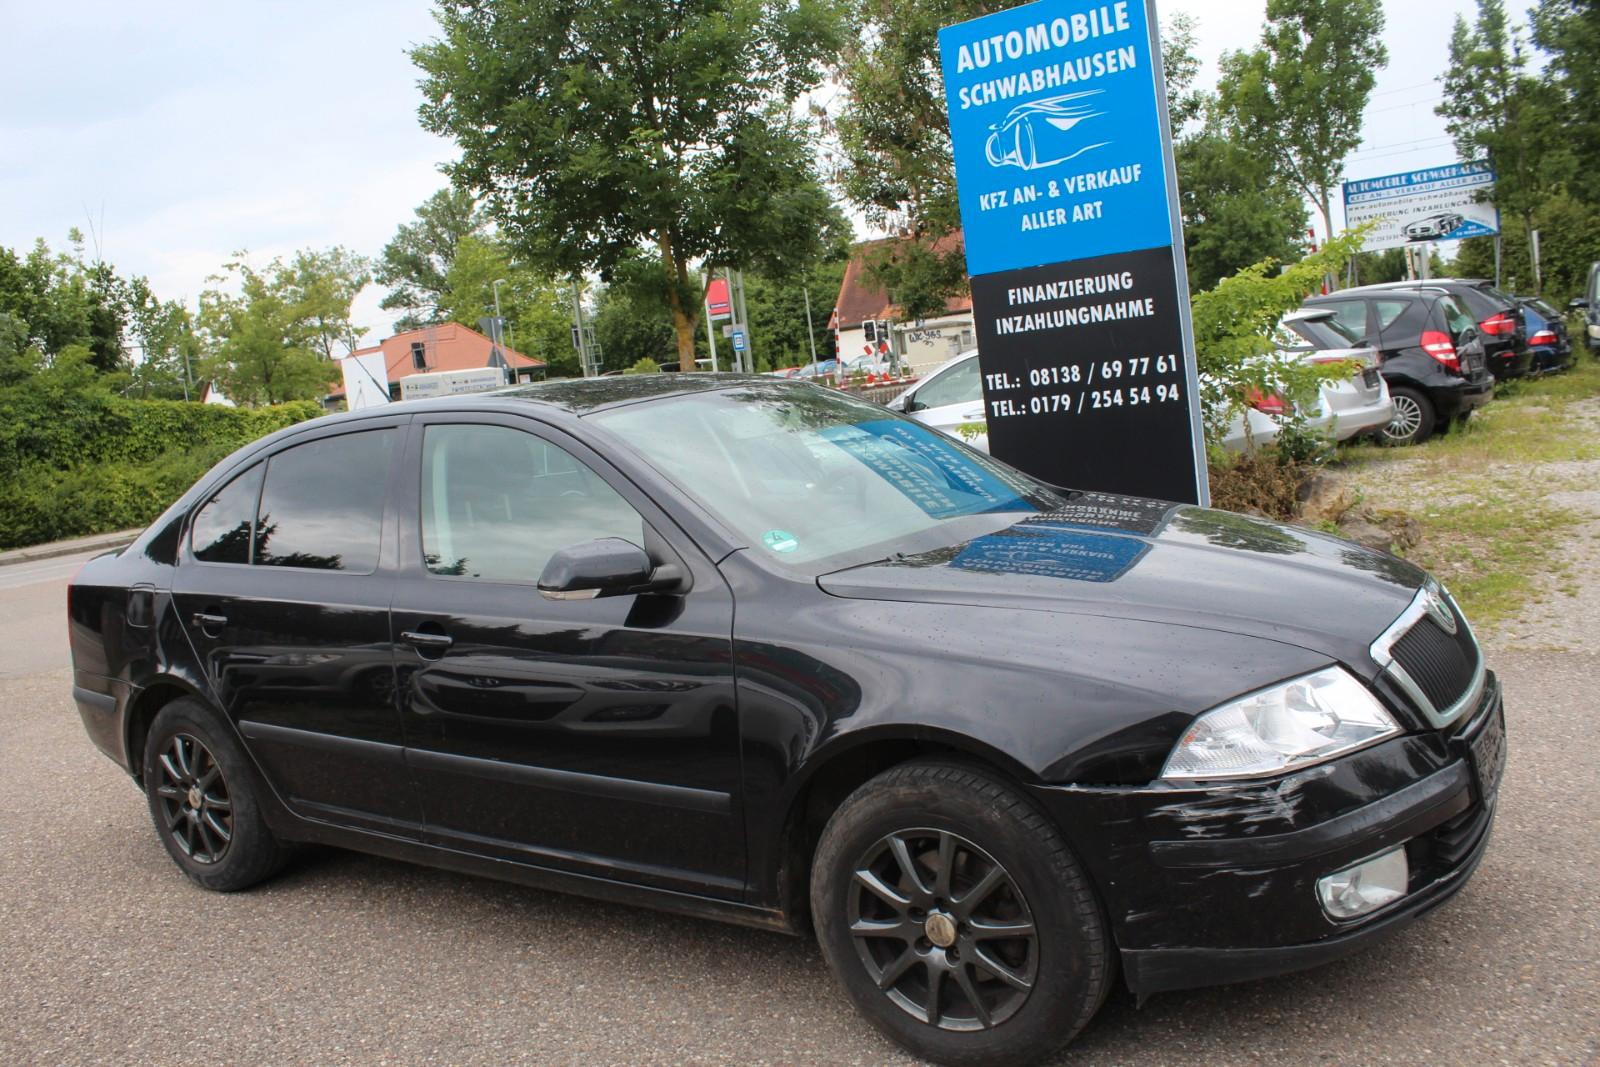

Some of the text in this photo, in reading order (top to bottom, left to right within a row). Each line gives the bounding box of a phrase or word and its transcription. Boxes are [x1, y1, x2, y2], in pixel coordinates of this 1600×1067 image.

[957, 1, 1130, 73] AUTOMOBILE
[959, 45, 1136, 110] SCHWABHAUSEN
[980, 163, 1142, 211] KFZ AN- & VERKAUF
[1346, 174, 1408, 194] AUTOMOBILE
[1021, 201, 1103, 232] ALLER ART
[1008, 271, 1133, 305] FINANZIERUNG
[996, 298, 1155, 335] INZAHLUNGNAHME
[986, 354, 1177, 391] TEL.: 08138 / 69 77 61
[991, 384, 1179, 417] TEL.: 0179 / 254 54 94
